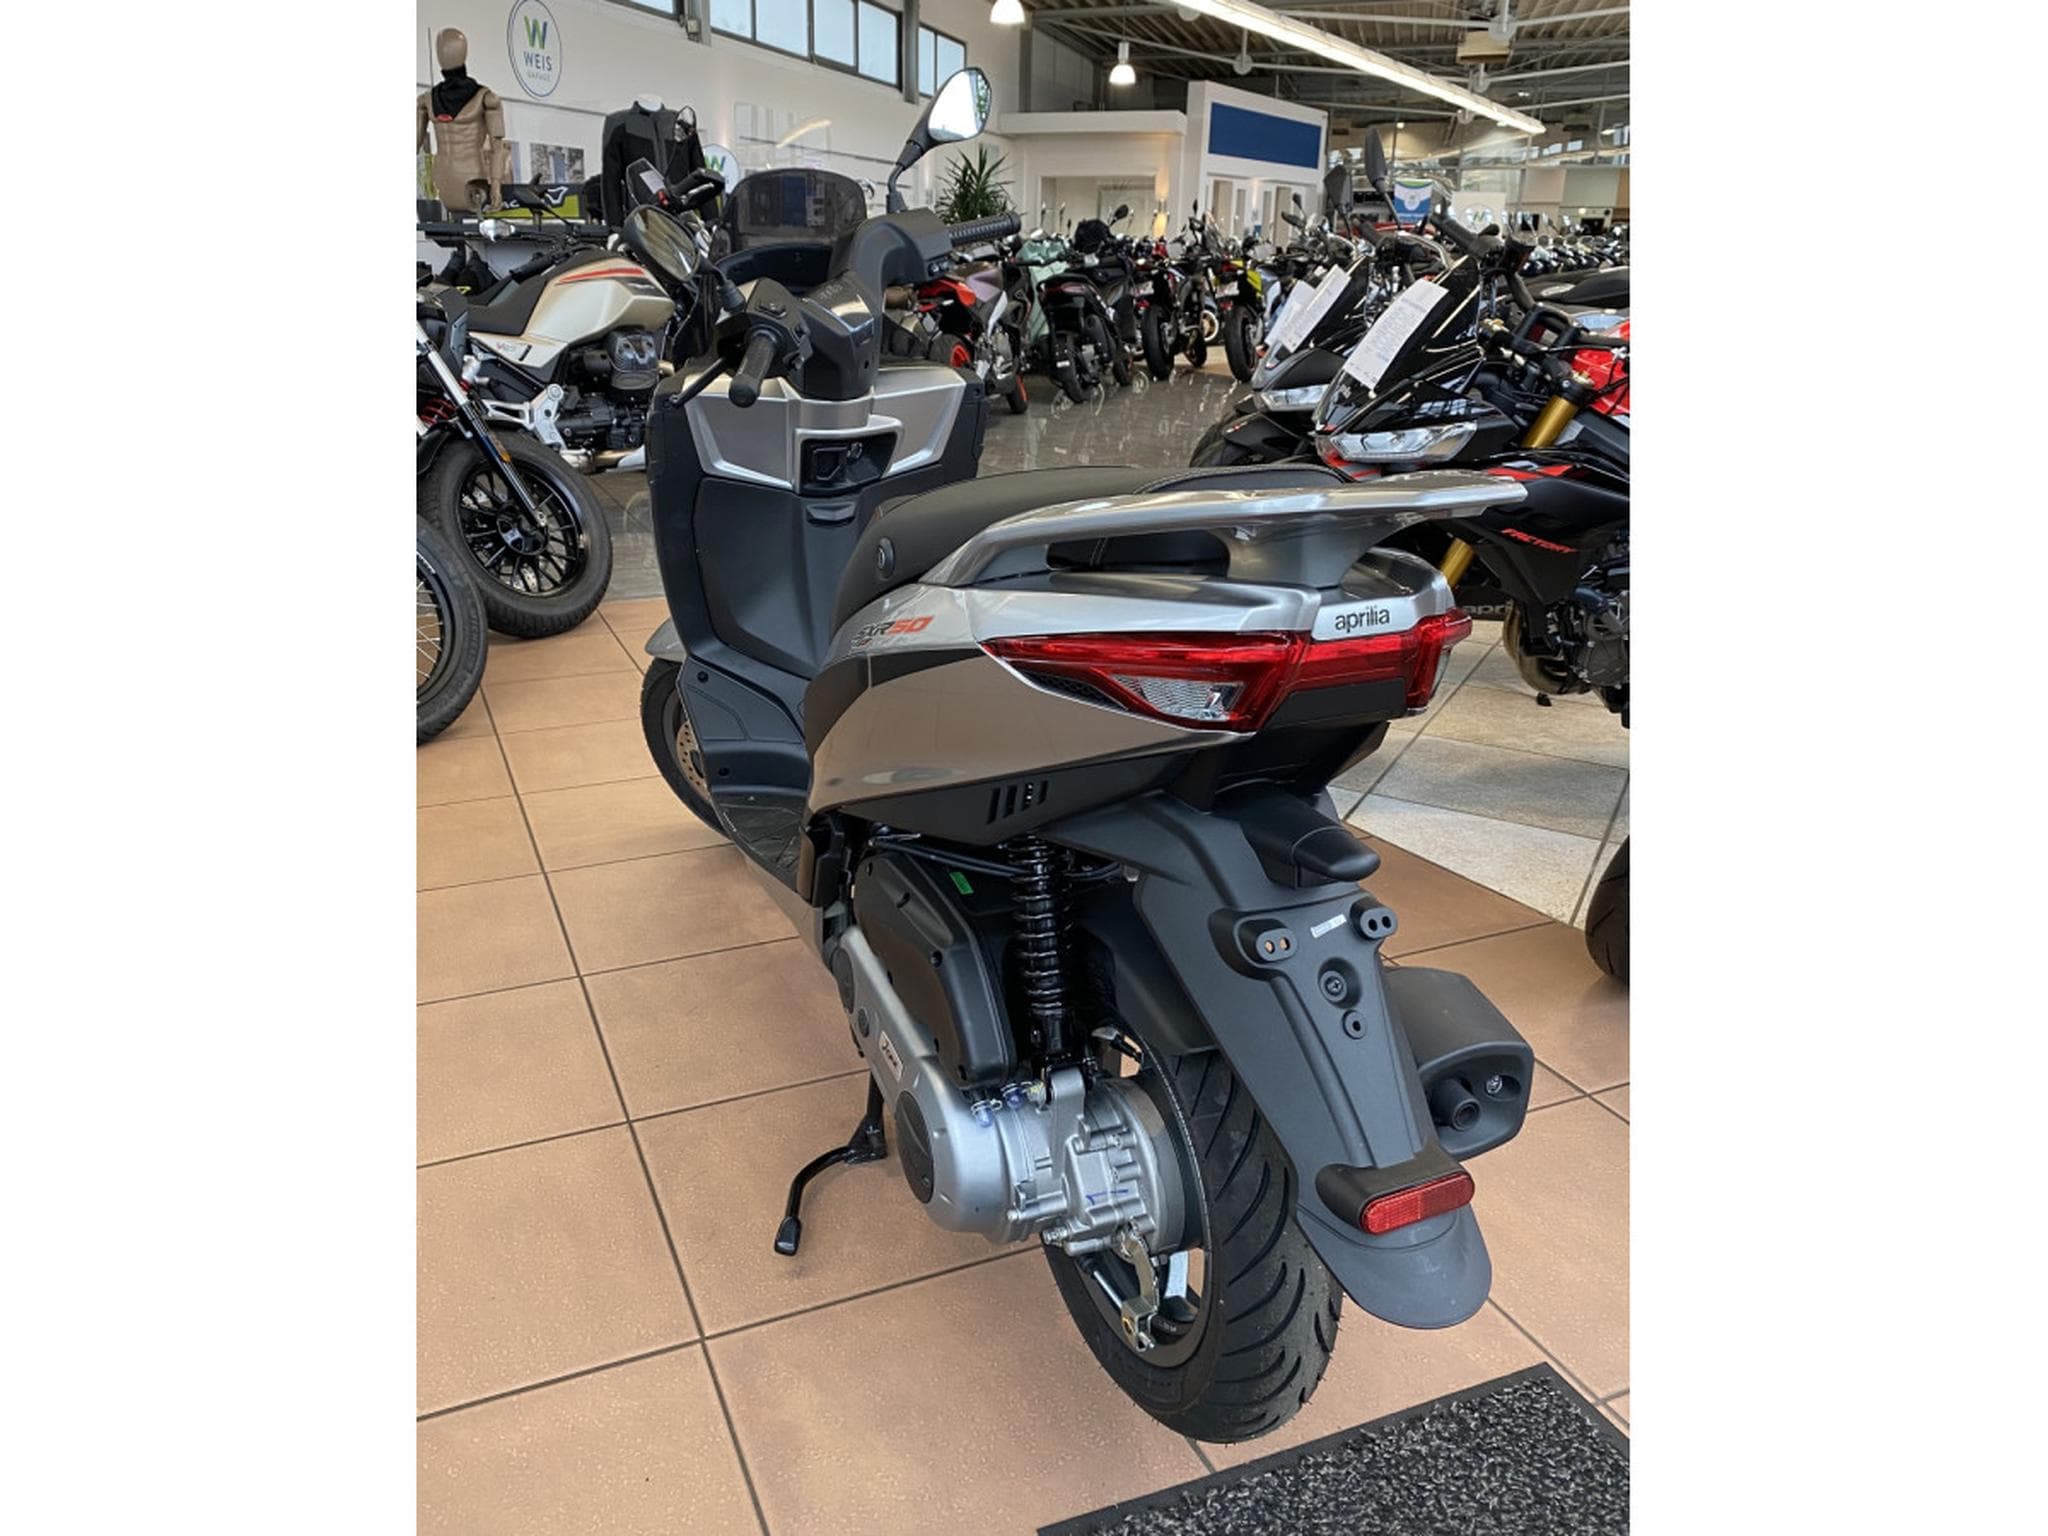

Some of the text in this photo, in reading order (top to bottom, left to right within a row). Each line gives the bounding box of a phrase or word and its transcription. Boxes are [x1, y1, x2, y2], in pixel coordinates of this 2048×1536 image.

[523, 51, 552, 71] WEIS
[1335, 605, 1390, 633] aprilia
[1462, 604, 1506, 615] apr
